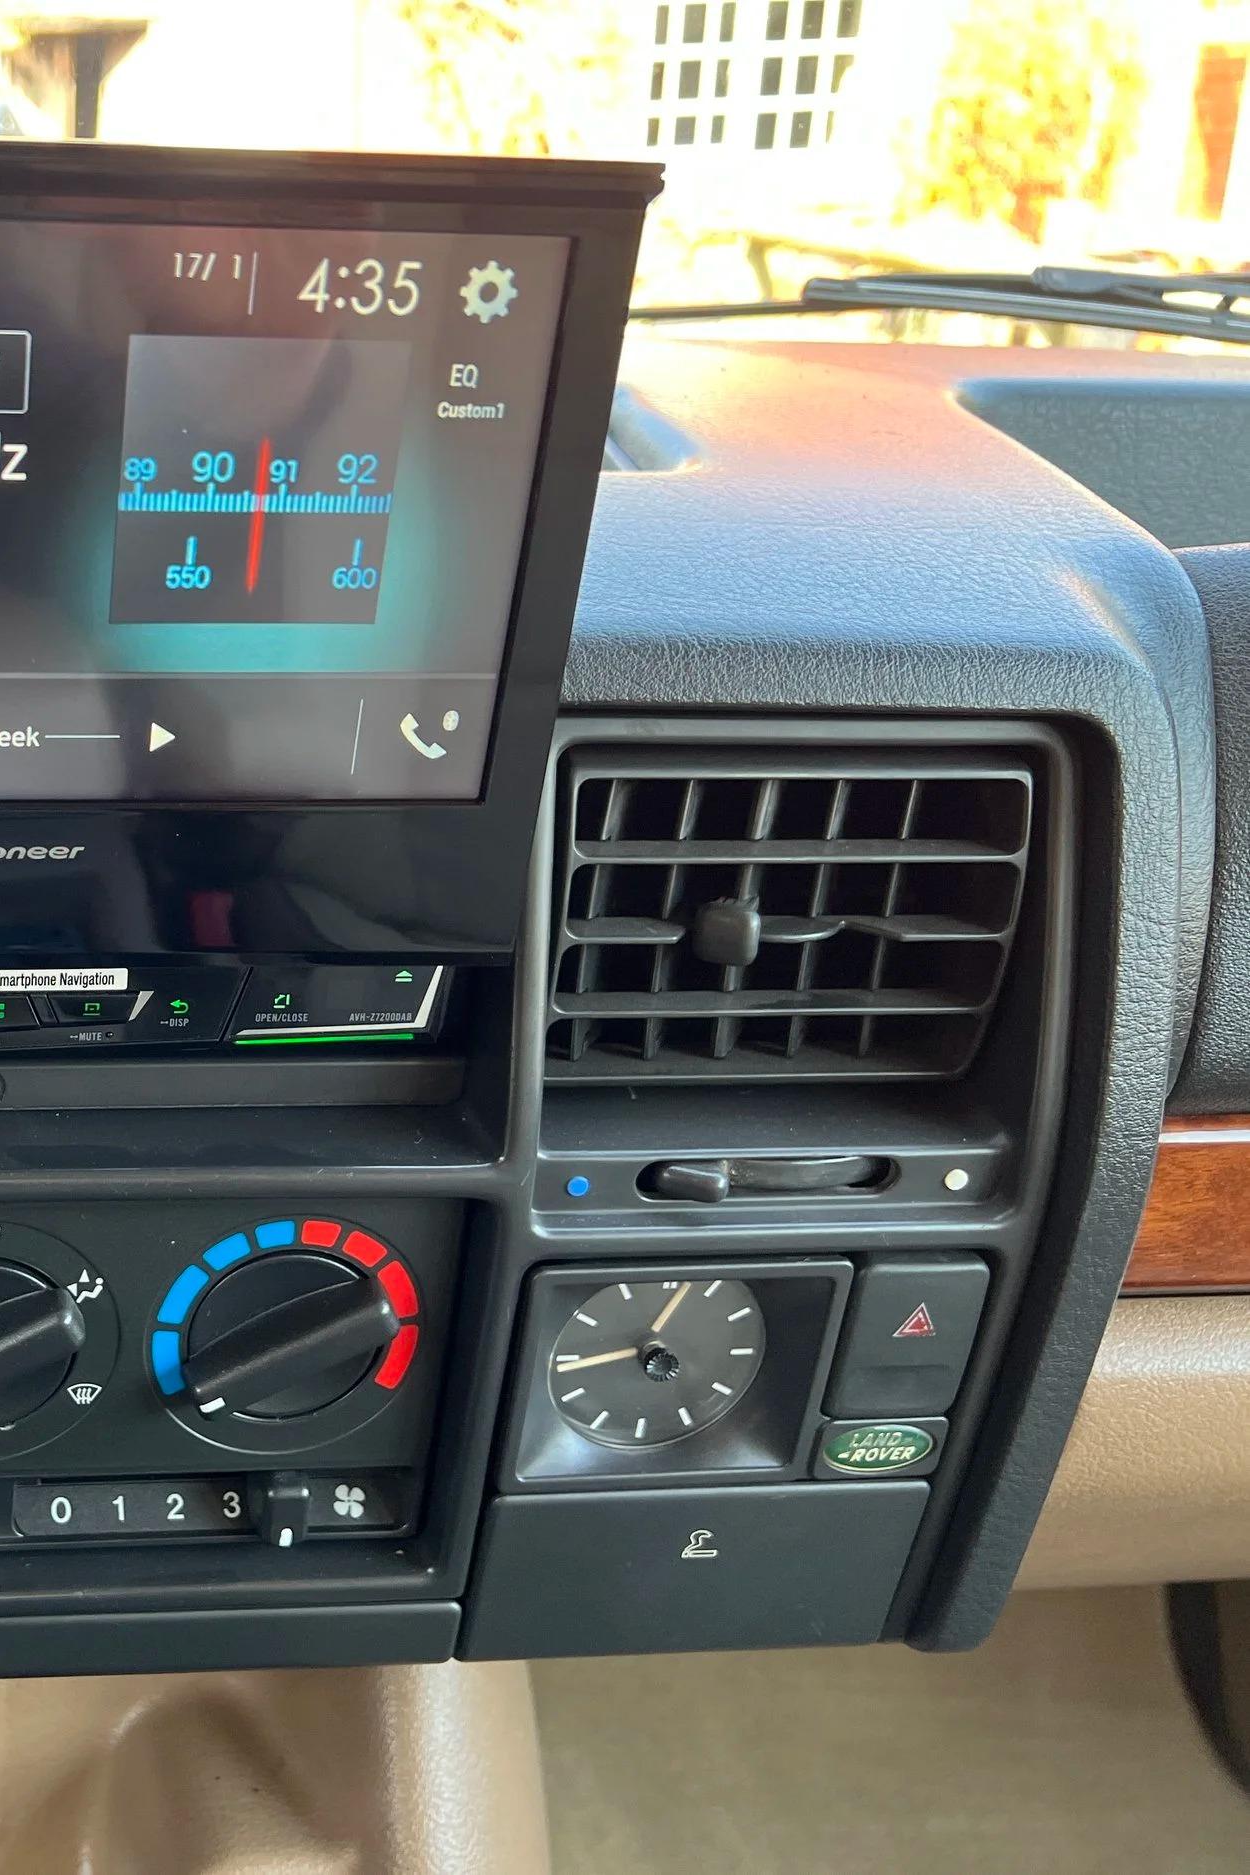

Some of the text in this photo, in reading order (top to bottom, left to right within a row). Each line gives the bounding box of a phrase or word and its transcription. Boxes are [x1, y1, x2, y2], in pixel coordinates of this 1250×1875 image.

[296, 257, 424, 316] 4:35
[449, 363, 478, 389] EQ
[436, 401, 505, 420] Custom1
[123, 451, 378, 485] 89 90 91 92
[165, 565, 377, 590] 550 600
[59, 972, 115, 988] Navigation
[169, 1018, 189, 1027] DISP
[255, 1013, 308, 1023] OPEN/CLOSE
[79, 1032, 102, 1042] MUTE
[50, 1491, 241, 1524] 0 1 2 3
